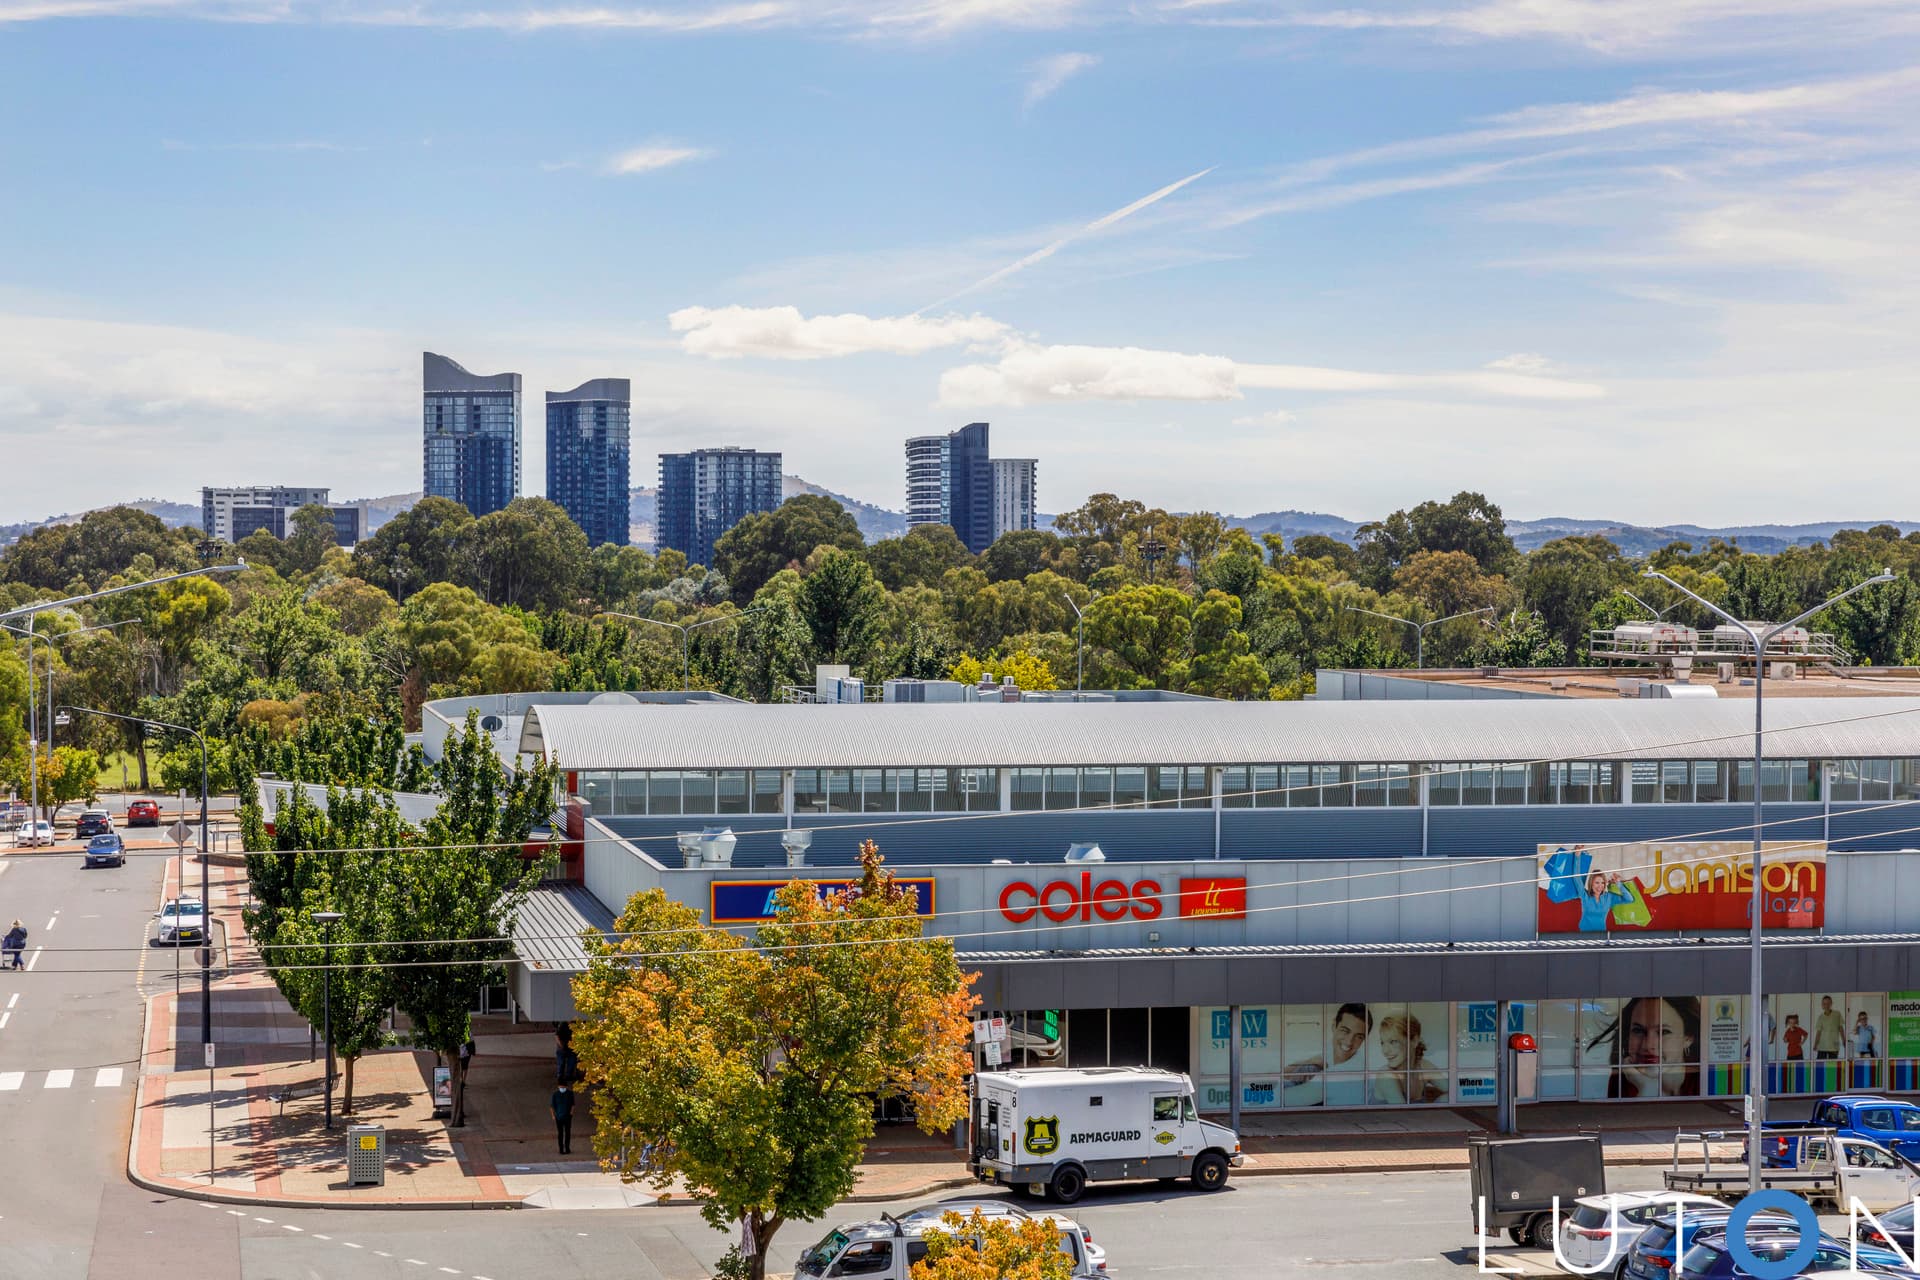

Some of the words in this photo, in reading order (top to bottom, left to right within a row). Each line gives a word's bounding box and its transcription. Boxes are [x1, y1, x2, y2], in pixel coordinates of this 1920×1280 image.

[1643, 850, 1816, 894] Jamison
[998, 870, 1163, 924] coles
[1215, 1013, 1265, 1036] FW
[1250, 1083, 1273, 1092] Seven
[1459, 1078, 1482, 1087] Where
[1208, 1088, 1231, 1104] Ope
[1244, 1088, 1274, 1104] Days
[1069, 1130, 1141, 1145] ARMAGUARD
